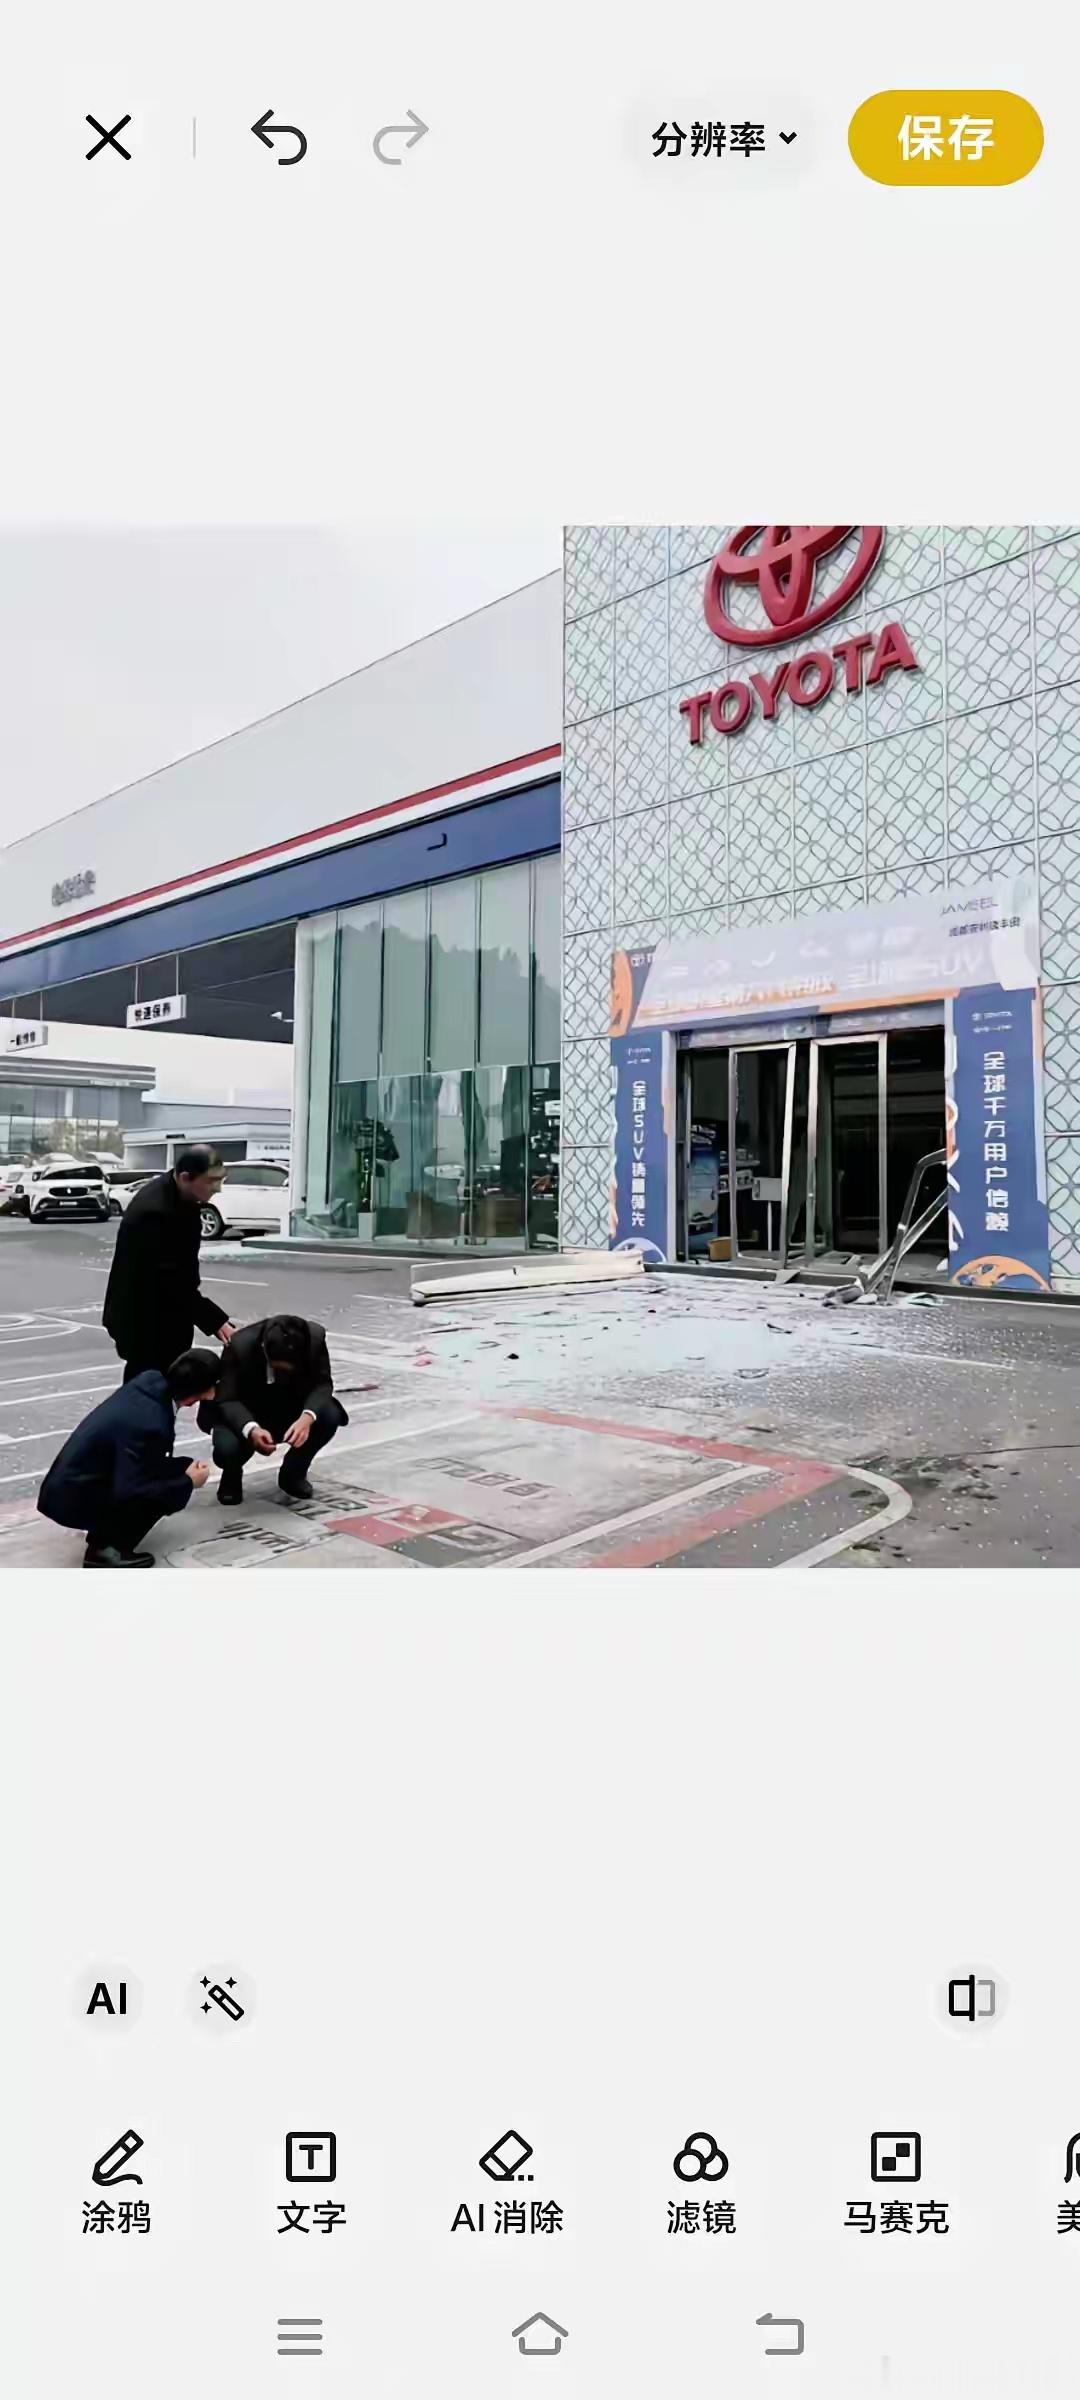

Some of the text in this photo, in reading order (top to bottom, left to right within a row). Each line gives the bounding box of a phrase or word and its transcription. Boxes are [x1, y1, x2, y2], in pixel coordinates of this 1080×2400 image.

[679, 622, 920, 746] TOYOTA
[983, 1050, 1010, 1233] 全球千万用户信赖
